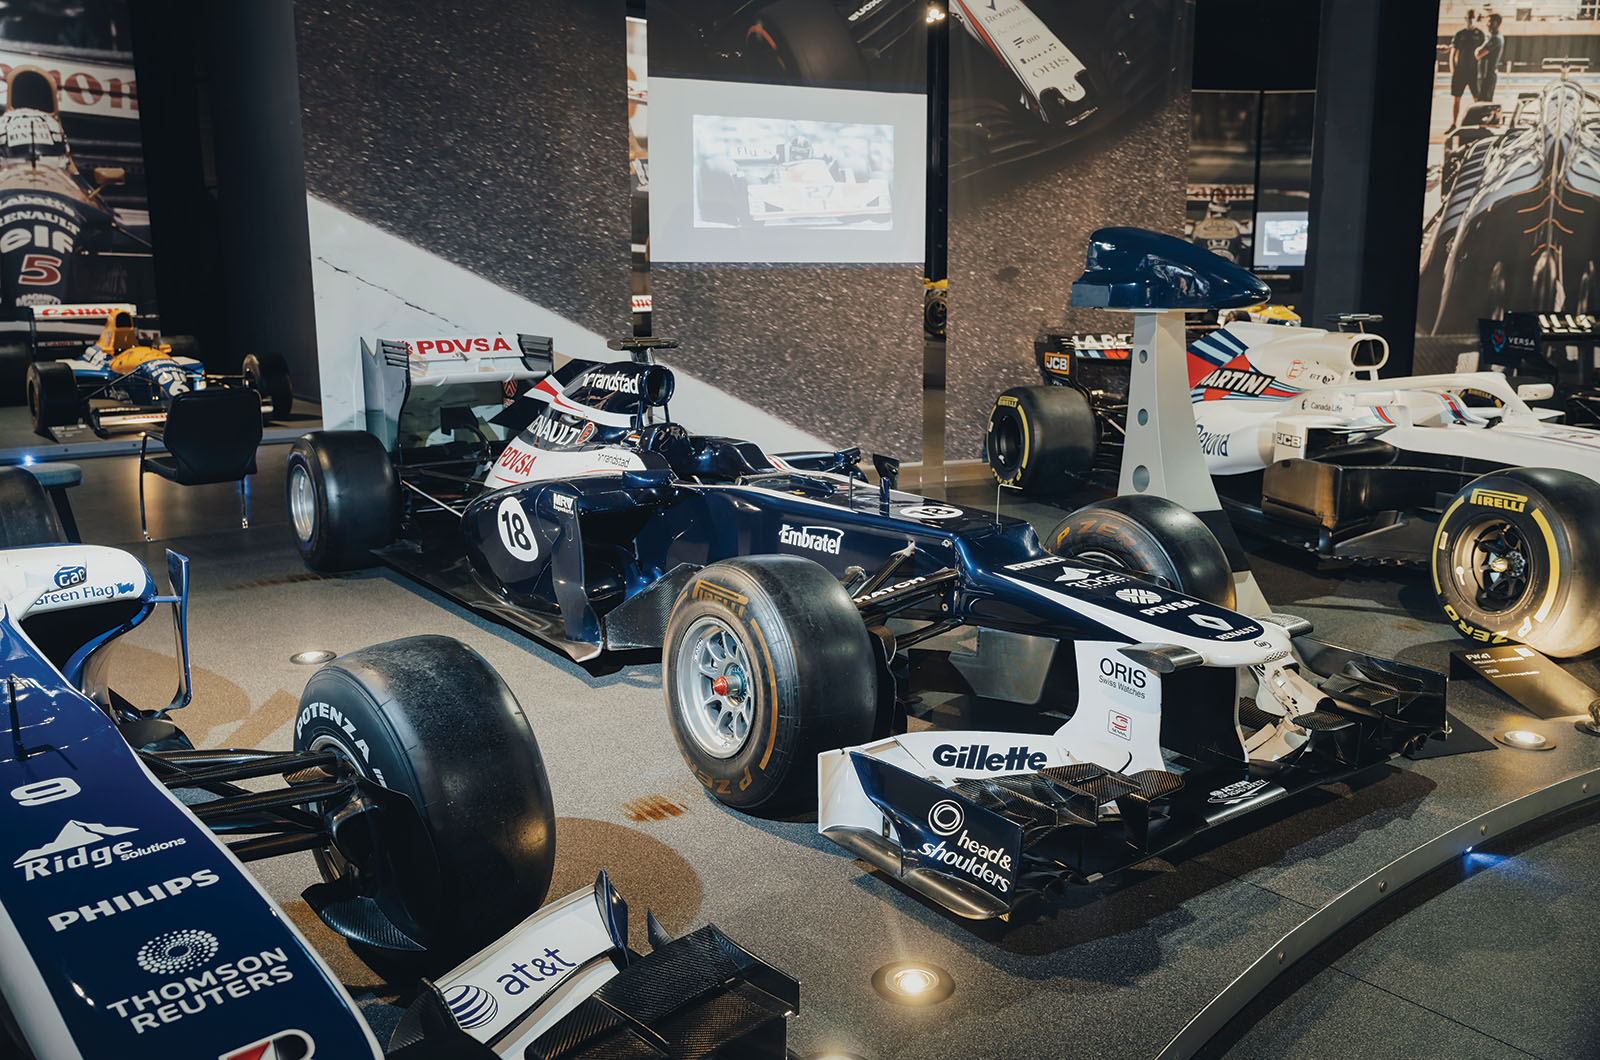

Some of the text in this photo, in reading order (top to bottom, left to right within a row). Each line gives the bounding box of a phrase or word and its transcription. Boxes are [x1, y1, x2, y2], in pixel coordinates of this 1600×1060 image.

[18, 254, 62, 286] 5
[416, 338, 512, 355] PDVSA
[1046, 356, 1068, 371] JCB
[1277, 432, 1301, 448] JCB
[498, 446, 537, 477] PDVSA
[1470, 488, 1528, 512] PIRELLI
[501, 511, 531, 551] 18
[778, 525, 842, 556] Embratel
[83, 585, 115, 603] Flag
[1139, 600, 1200, 616] PDVSA
[1099, 675, 1146, 699] Swiss Watches
[1100, 657, 1147, 688] ORIS
[296, 702, 369, 764] POTENZA
[932, 744, 1048, 771] Gillette
[10, 777, 81, 807] 9
[14, 836, 187, 882] Ridge solutions
[918, 841, 1011, 893] shoulders
[48, 869, 220, 932] PHILIPS
[106, 947, 289, 1020] THOMSON
[496, 947, 577, 997] at&t
[130, 964, 294, 1035] REUTERS
